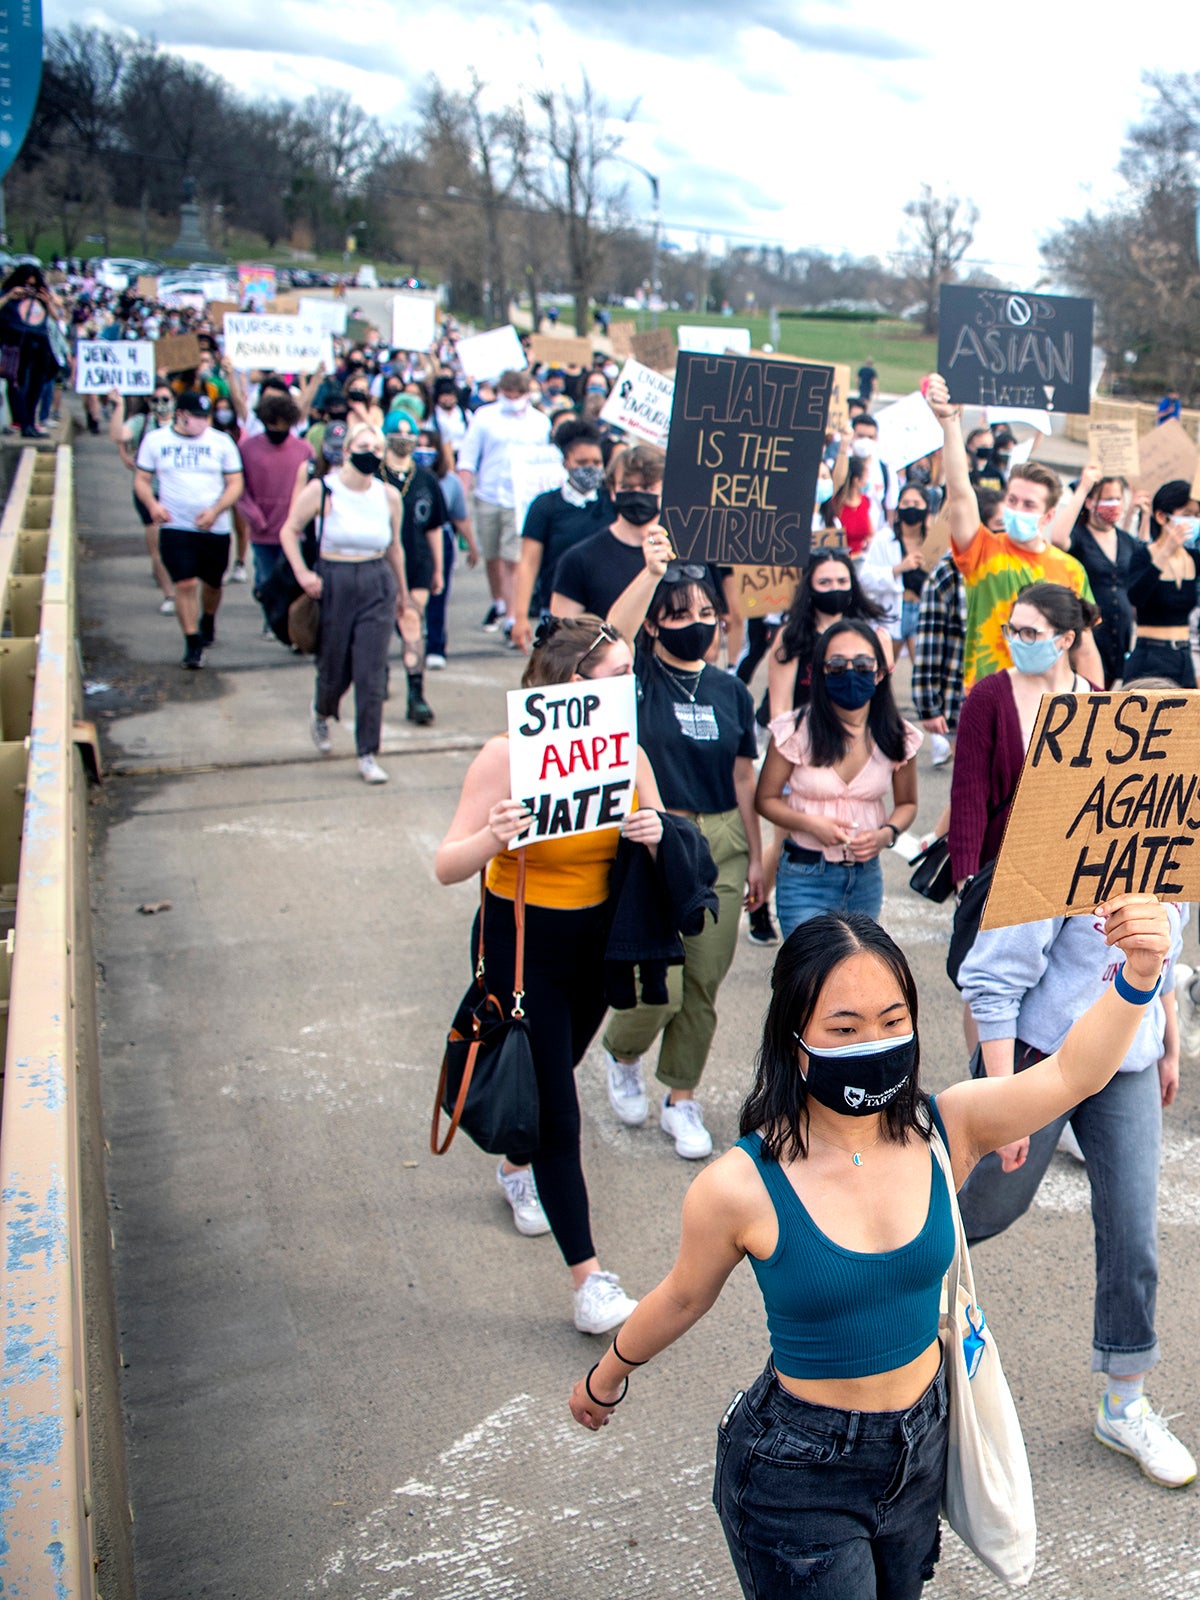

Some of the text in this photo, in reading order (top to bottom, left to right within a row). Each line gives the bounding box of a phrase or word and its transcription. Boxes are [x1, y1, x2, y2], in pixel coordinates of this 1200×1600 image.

[975, 290, 1056, 326] STOP
[949, 324, 1075, 384] ASIAN
[684, 357, 830, 431] HATE
[697, 429, 794, 472] IS THE
[711, 473, 777, 510] REAL
[665, 506, 801, 566] VIRUS
[519, 693, 601, 737] STOP
[1032, 693, 1189, 767] RISE
[539, 732, 630, 781] AAPI
[517, 778, 632, 842] HATE
[1066, 831, 1195, 906] HATE
